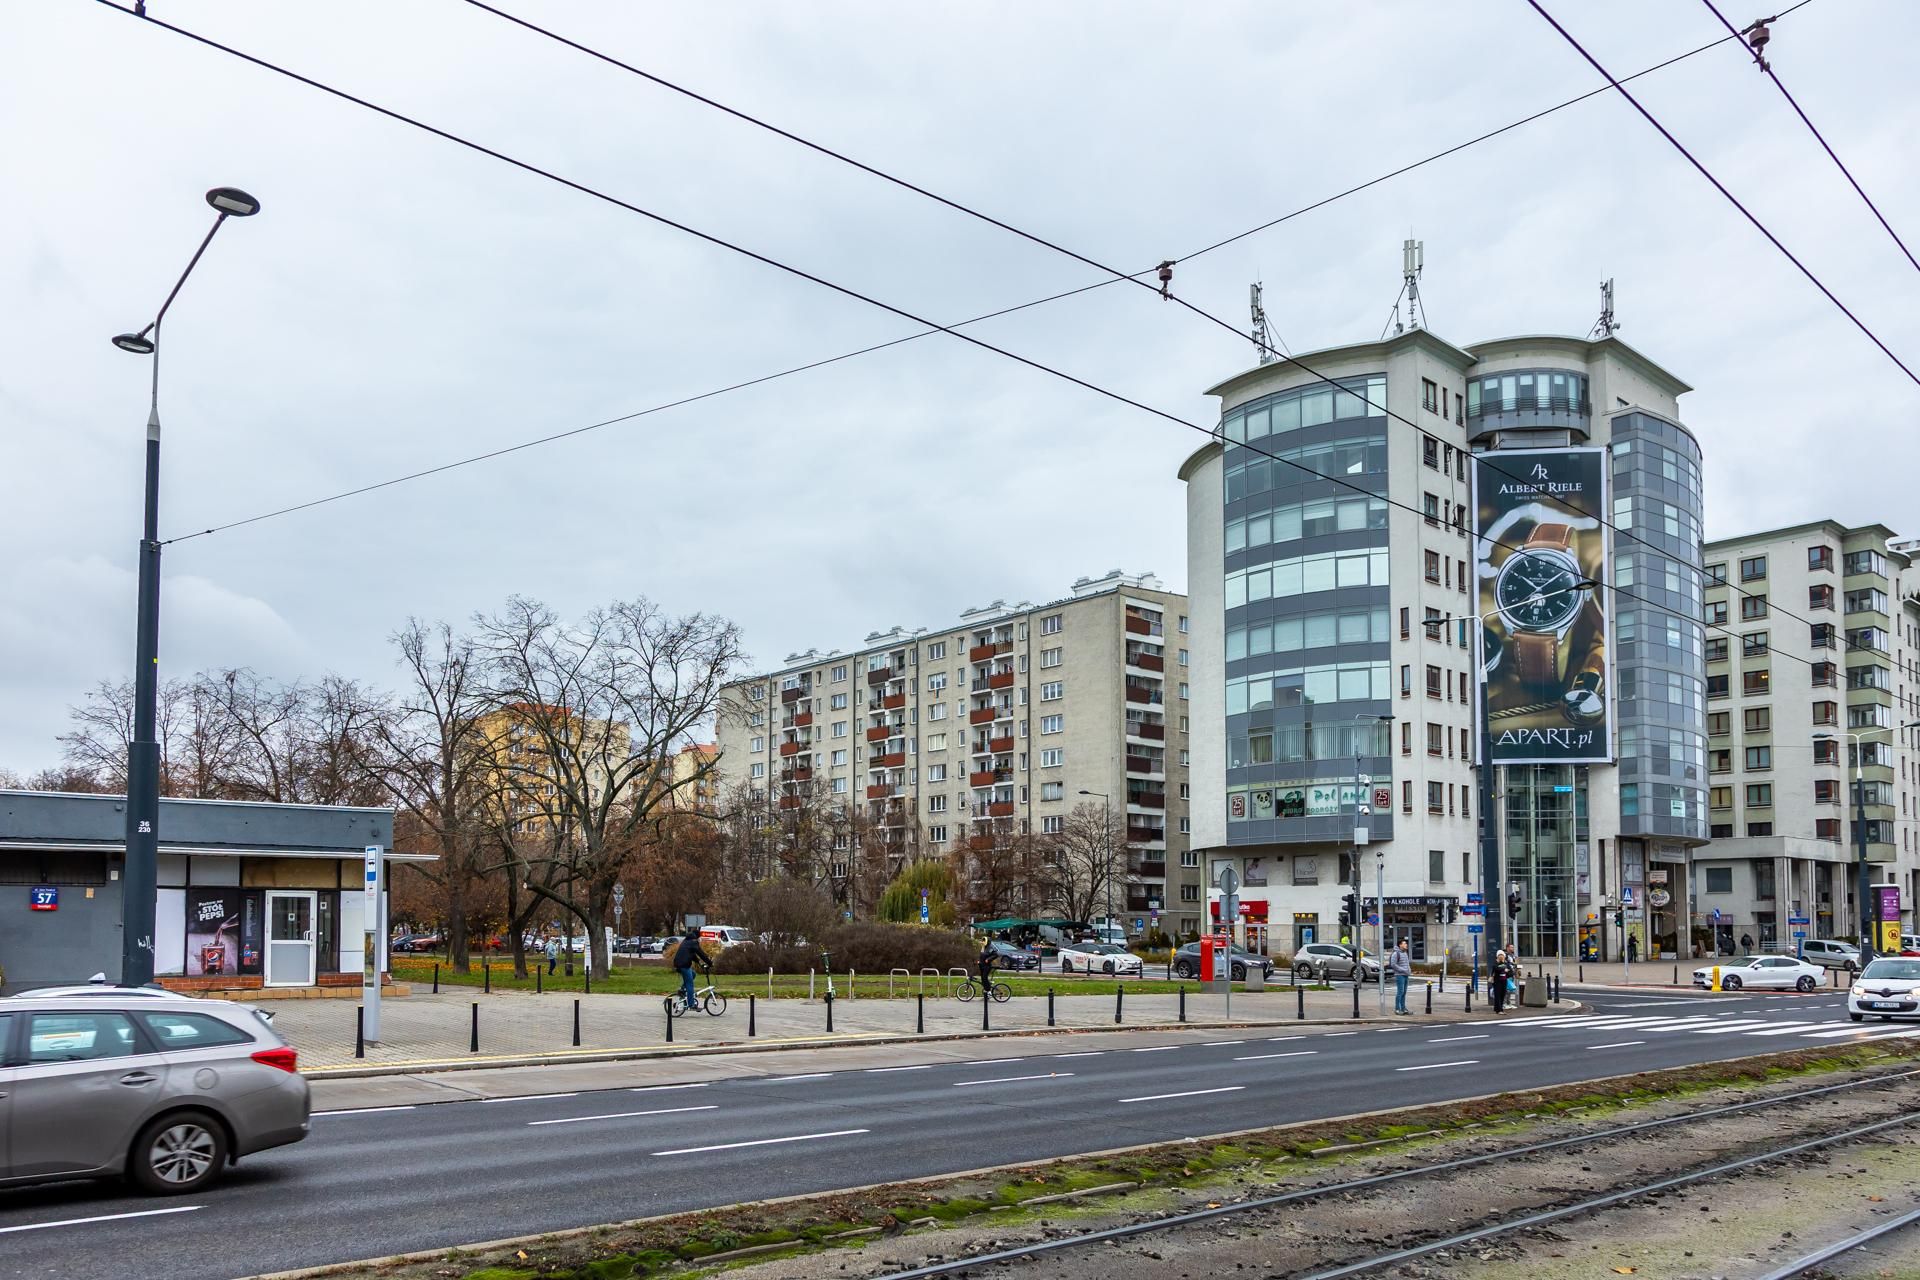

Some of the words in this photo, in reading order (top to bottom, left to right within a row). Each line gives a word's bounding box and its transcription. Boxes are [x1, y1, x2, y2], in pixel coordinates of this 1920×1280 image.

[1498, 483, 1545, 495] ALBERT
[1548, 482, 1583, 493] RIELE
[1496, 727, 1593, 749] APART.pl
[1377, 791, 1388, 799] 25
[1233, 798, 1242, 809] 25
[202, 903, 223, 914] STÓŁ
[199, 910, 224, 921] PEPSI
